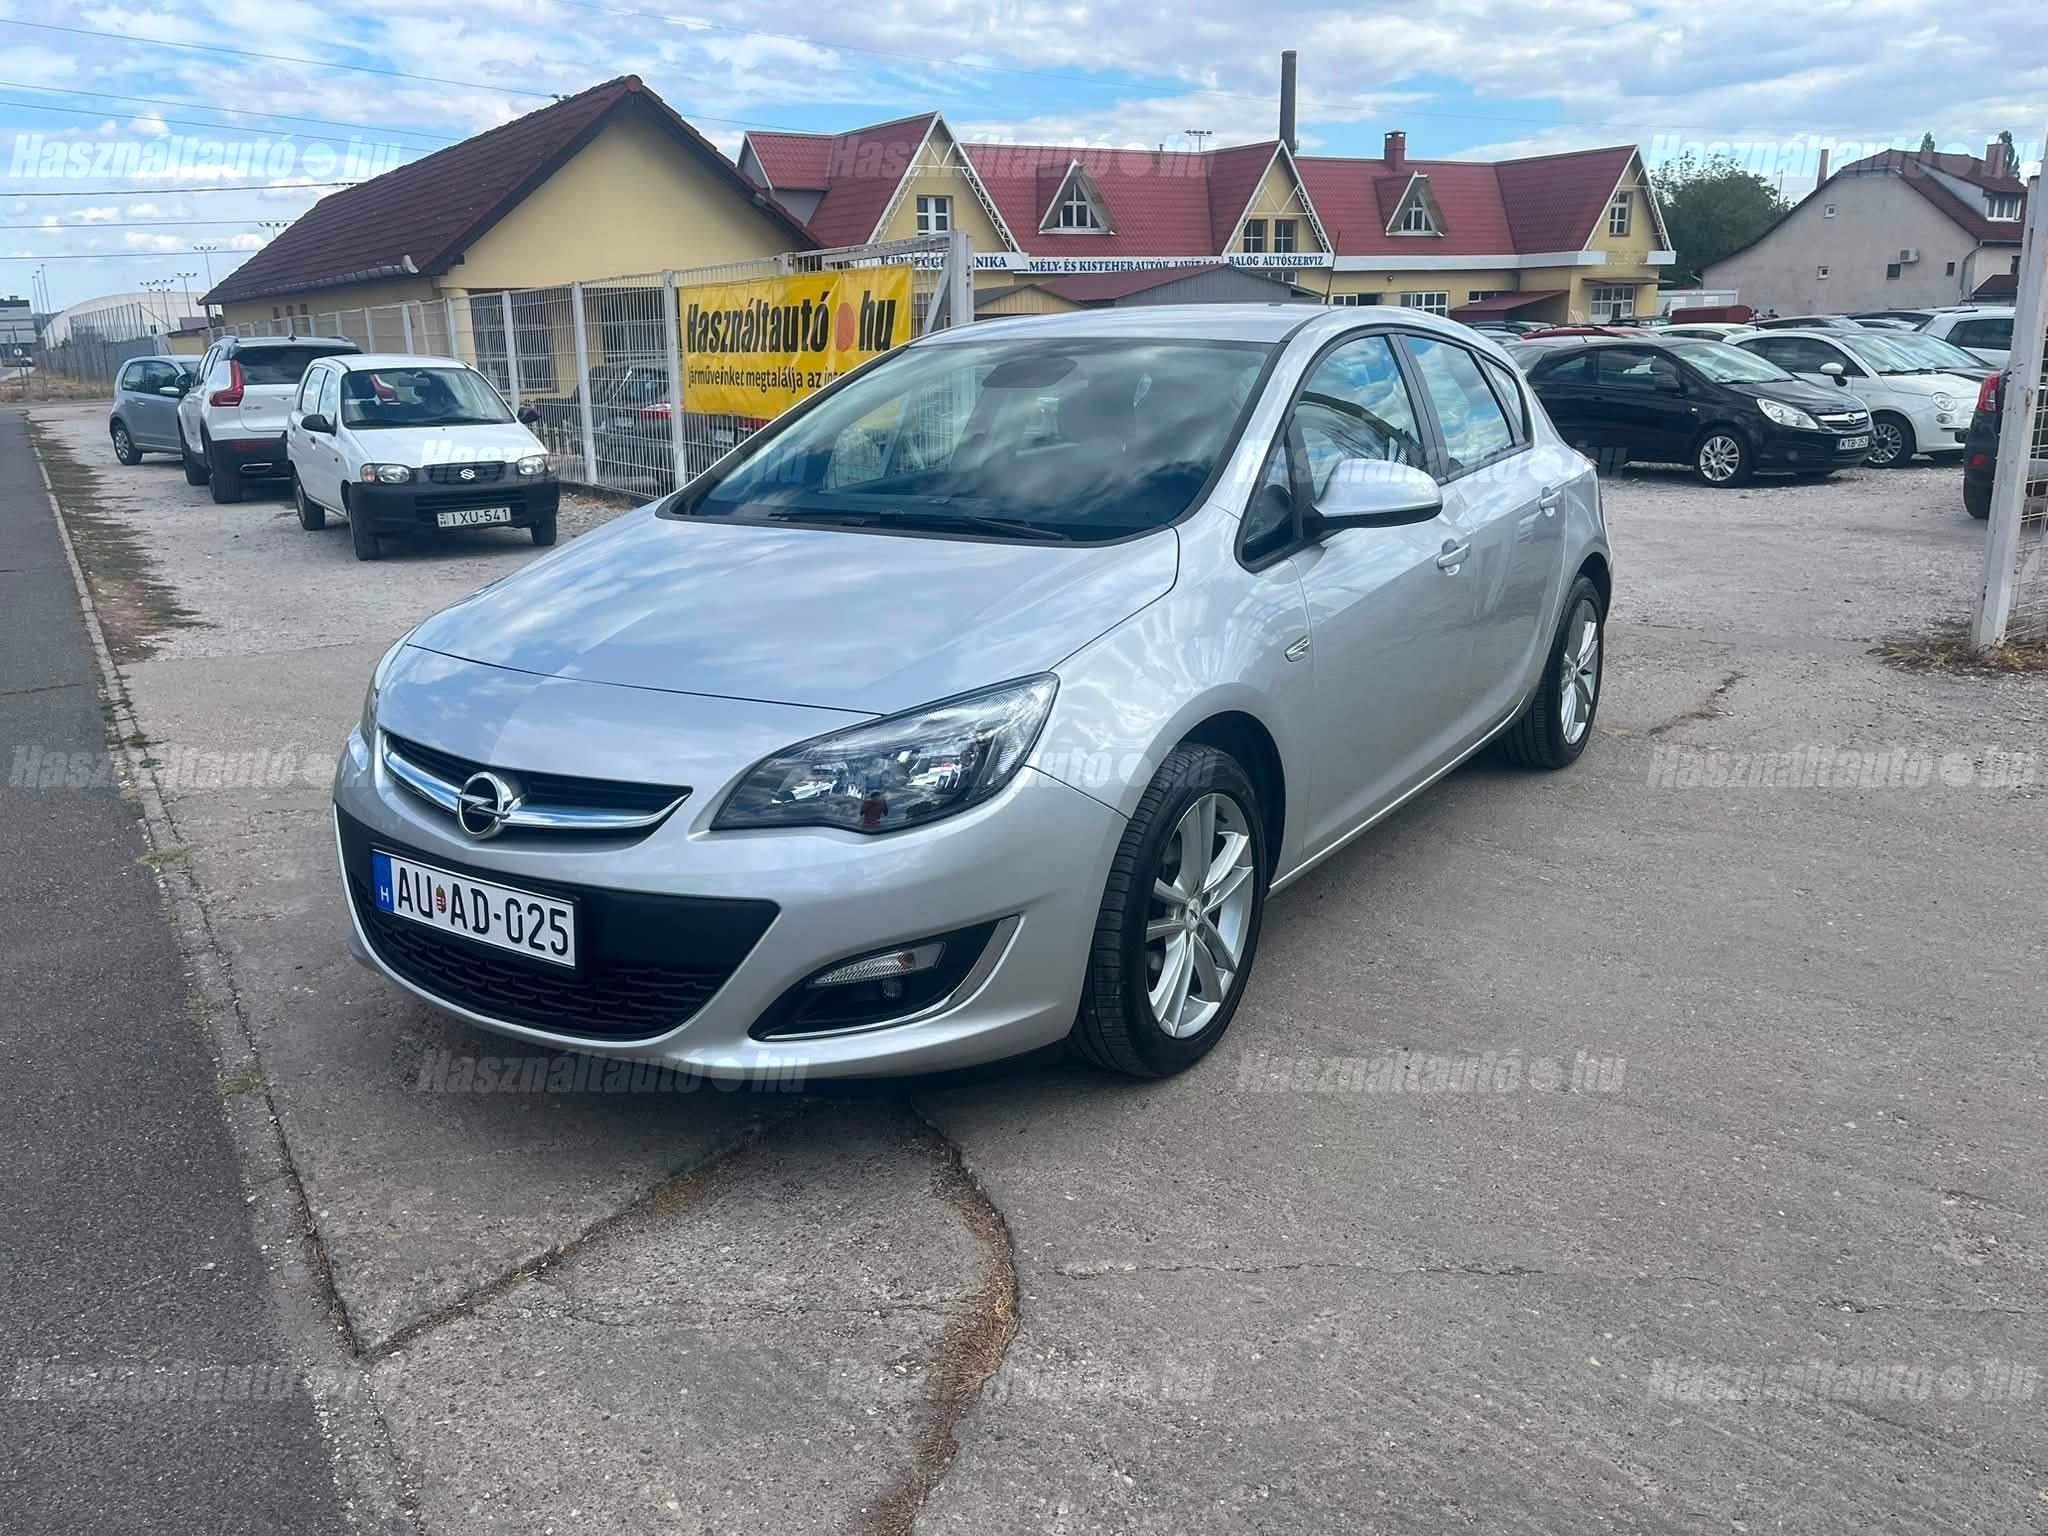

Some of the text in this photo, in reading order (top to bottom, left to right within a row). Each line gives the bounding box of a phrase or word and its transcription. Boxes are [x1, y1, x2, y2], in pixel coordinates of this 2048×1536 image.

[1229, 256, 1259, 266] BALOG
[746, 365, 803, 394] megtalálja
[807, 370, 821, 388] az
[452, 508, 508, 525] IXU-541
[380, 866, 569, 956] H AU AD-025
